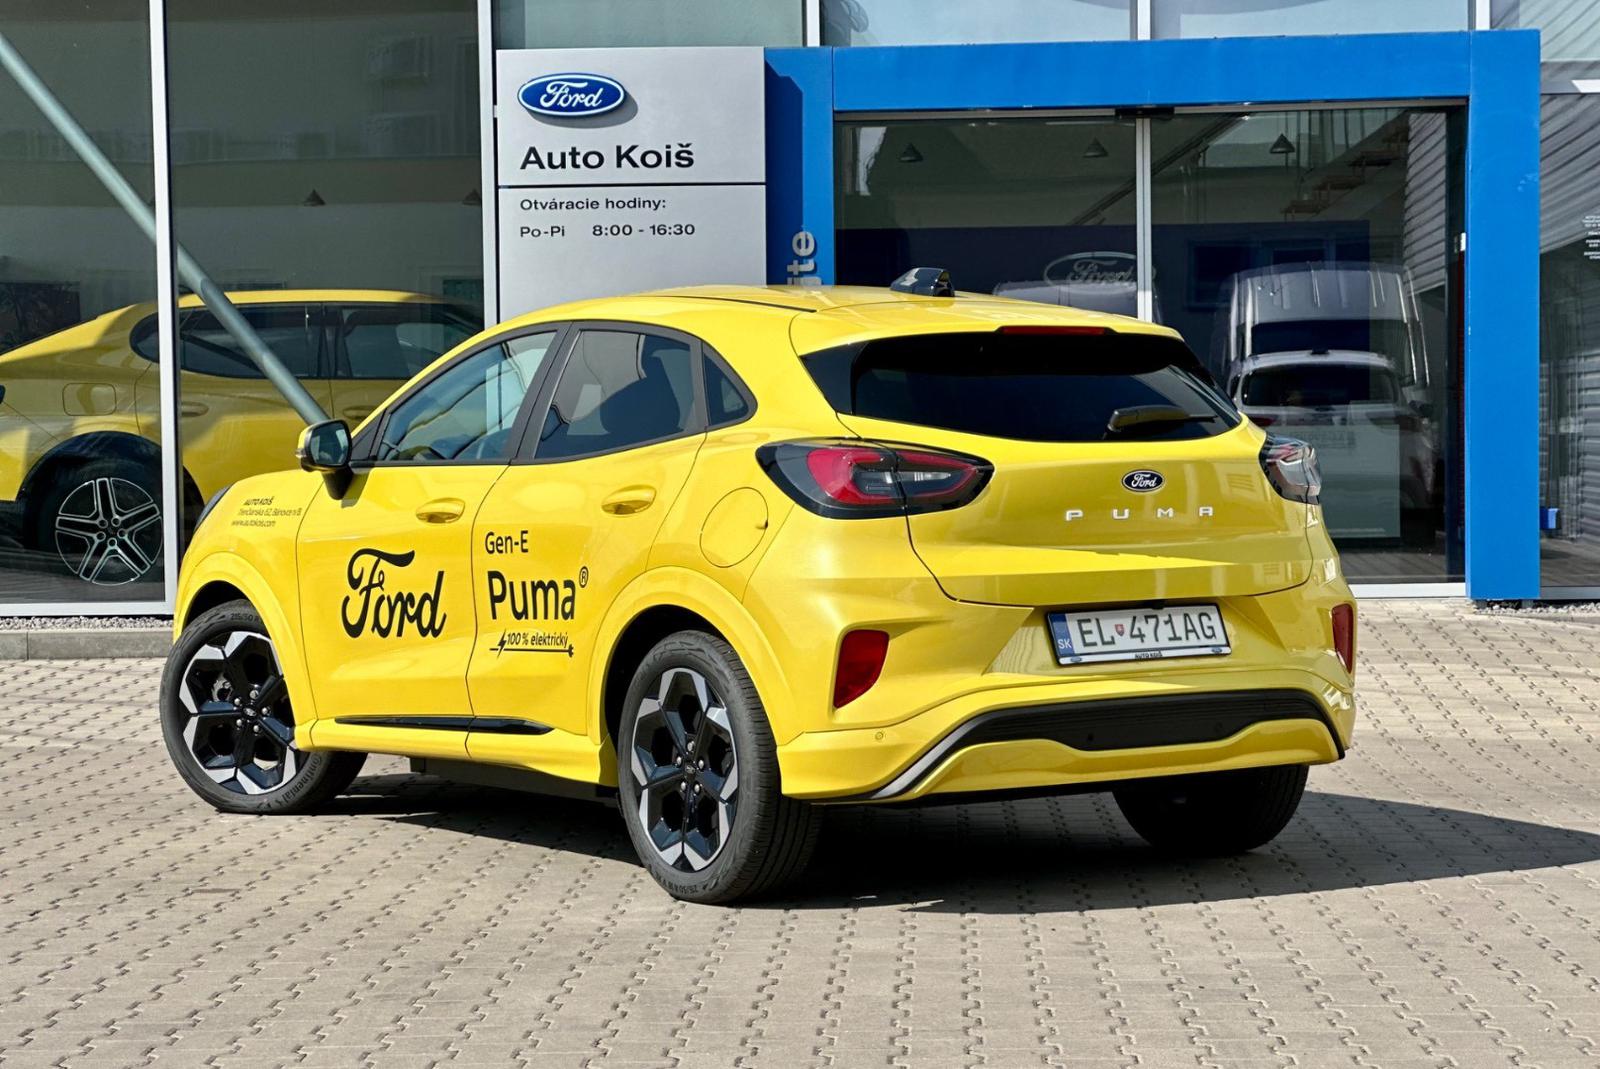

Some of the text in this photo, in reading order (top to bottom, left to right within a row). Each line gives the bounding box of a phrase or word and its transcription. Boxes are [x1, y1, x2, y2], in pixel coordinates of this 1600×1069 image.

[540, 81, 604, 107] Ford
[520, 143, 695, 169] Auto Koiš
[520, 197, 666, 211] Otváracie hodiny:
[592, 224, 632, 236] 8:00
[649, 224, 695, 236] 16:30
[1131, 473, 1157, 487] Ford
[1065, 506, 1213, 521] PUMA
[485, 530, 528, 554] Gen-E
[341, 548, 447, 638] Ford
[1077, 612, 1217, 647] EL 471AG
[507, 632, 520, 645] 100
[531, 632, 568, 648] elektrický
[1058, 639, 1072, 649] SK
